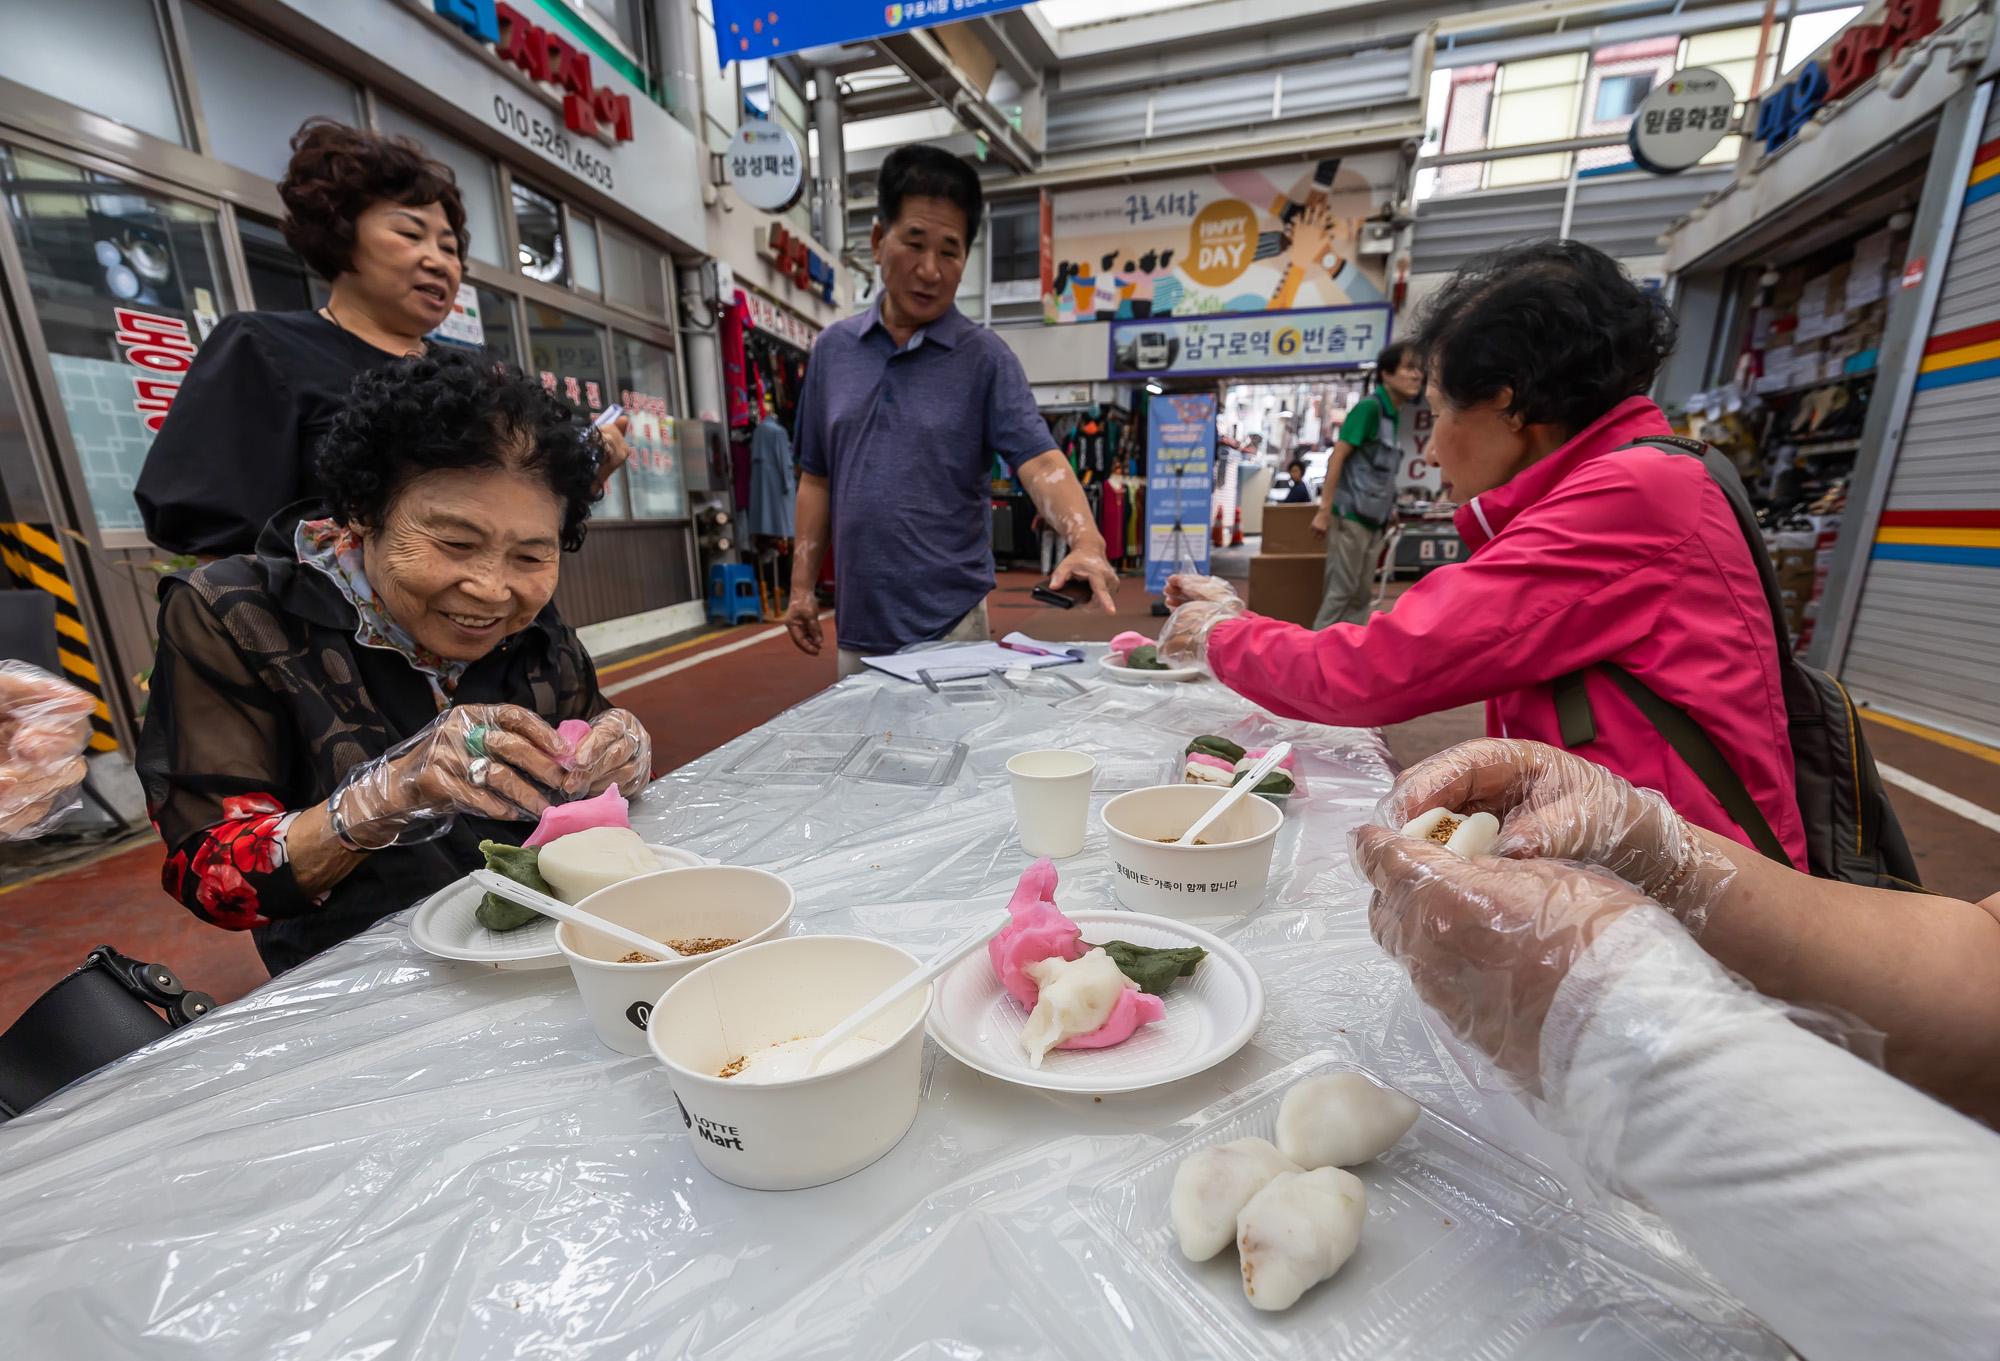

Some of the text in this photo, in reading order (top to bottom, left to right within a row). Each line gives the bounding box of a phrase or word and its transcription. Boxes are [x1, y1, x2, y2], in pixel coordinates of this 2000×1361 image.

[732, 154, 794, 177] 삼성패션
[1126, 191, 1199, 225] 구로시장
[1200, 216, 1248, 238] HAPPY
[1198, 243, 1247, 271] DAY
[1185, 330, 1271, 360] 남구로역
[1186, 882, 1206, 893] 함께
[1210, 880, 1238, 893] 합니다
[694, 1113, 740, 1137] LOTTE
[697, 1124, 744, 1151] Mart
